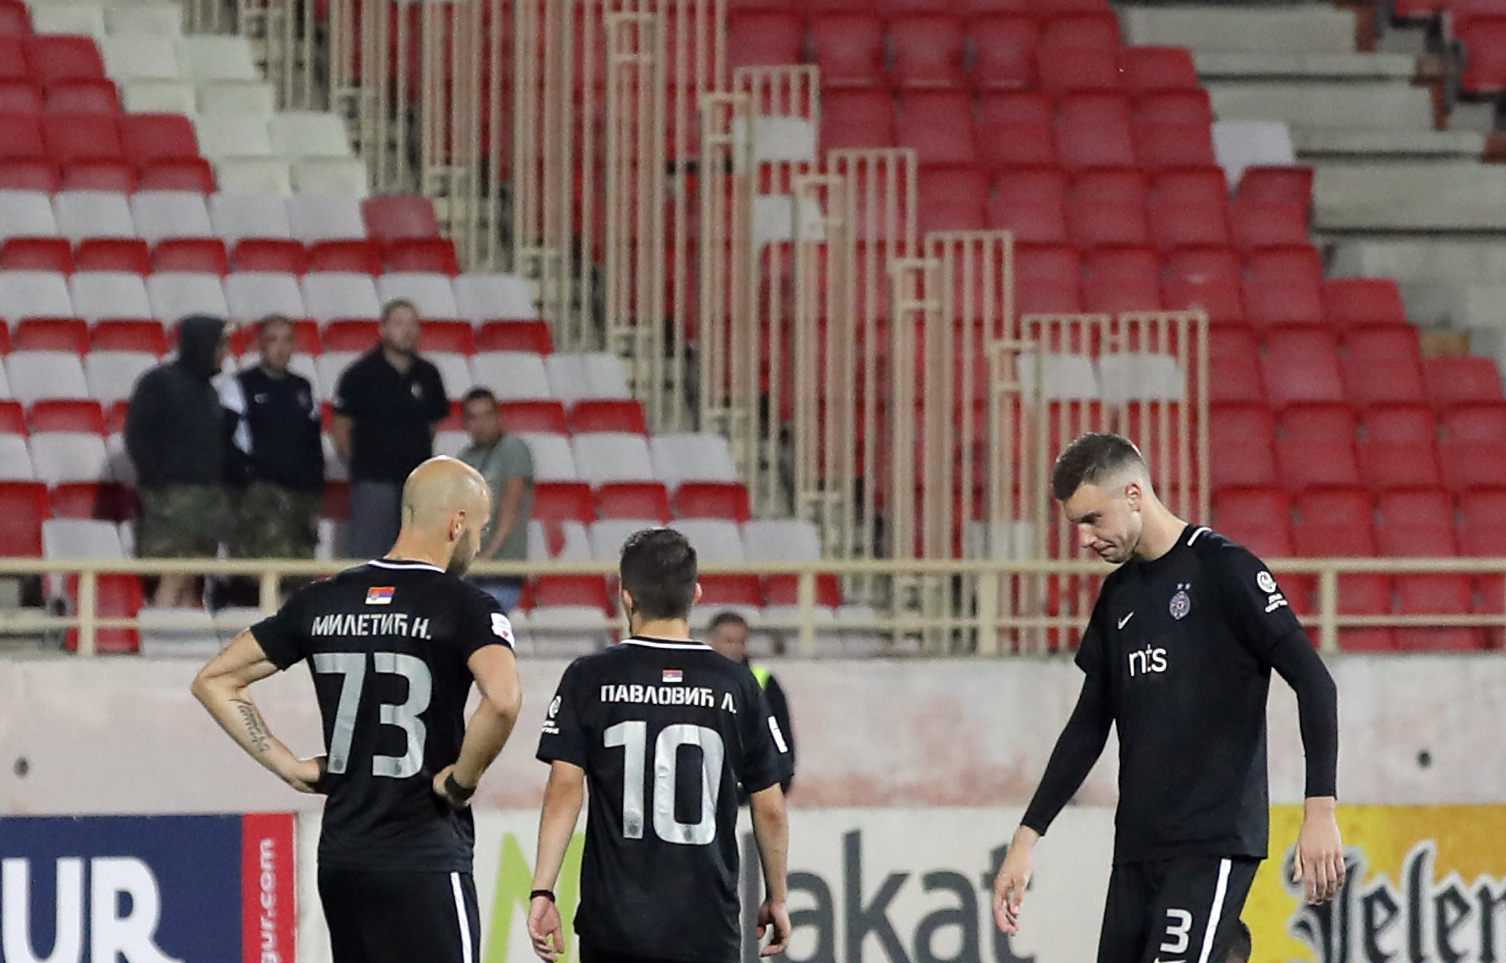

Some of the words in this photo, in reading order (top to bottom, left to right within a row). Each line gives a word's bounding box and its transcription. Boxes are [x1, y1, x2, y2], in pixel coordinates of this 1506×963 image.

[311, 613, 409, 637] МИЛЕТИЋ
[1128, 643, 1168, 677] nts
[313, 652, 432, 779] 73
[600, 684, 715, 708] ПАВЛОВИЋ
[603, 720, 725, 845] 10
[1160, 908, 1193, 954] 3
